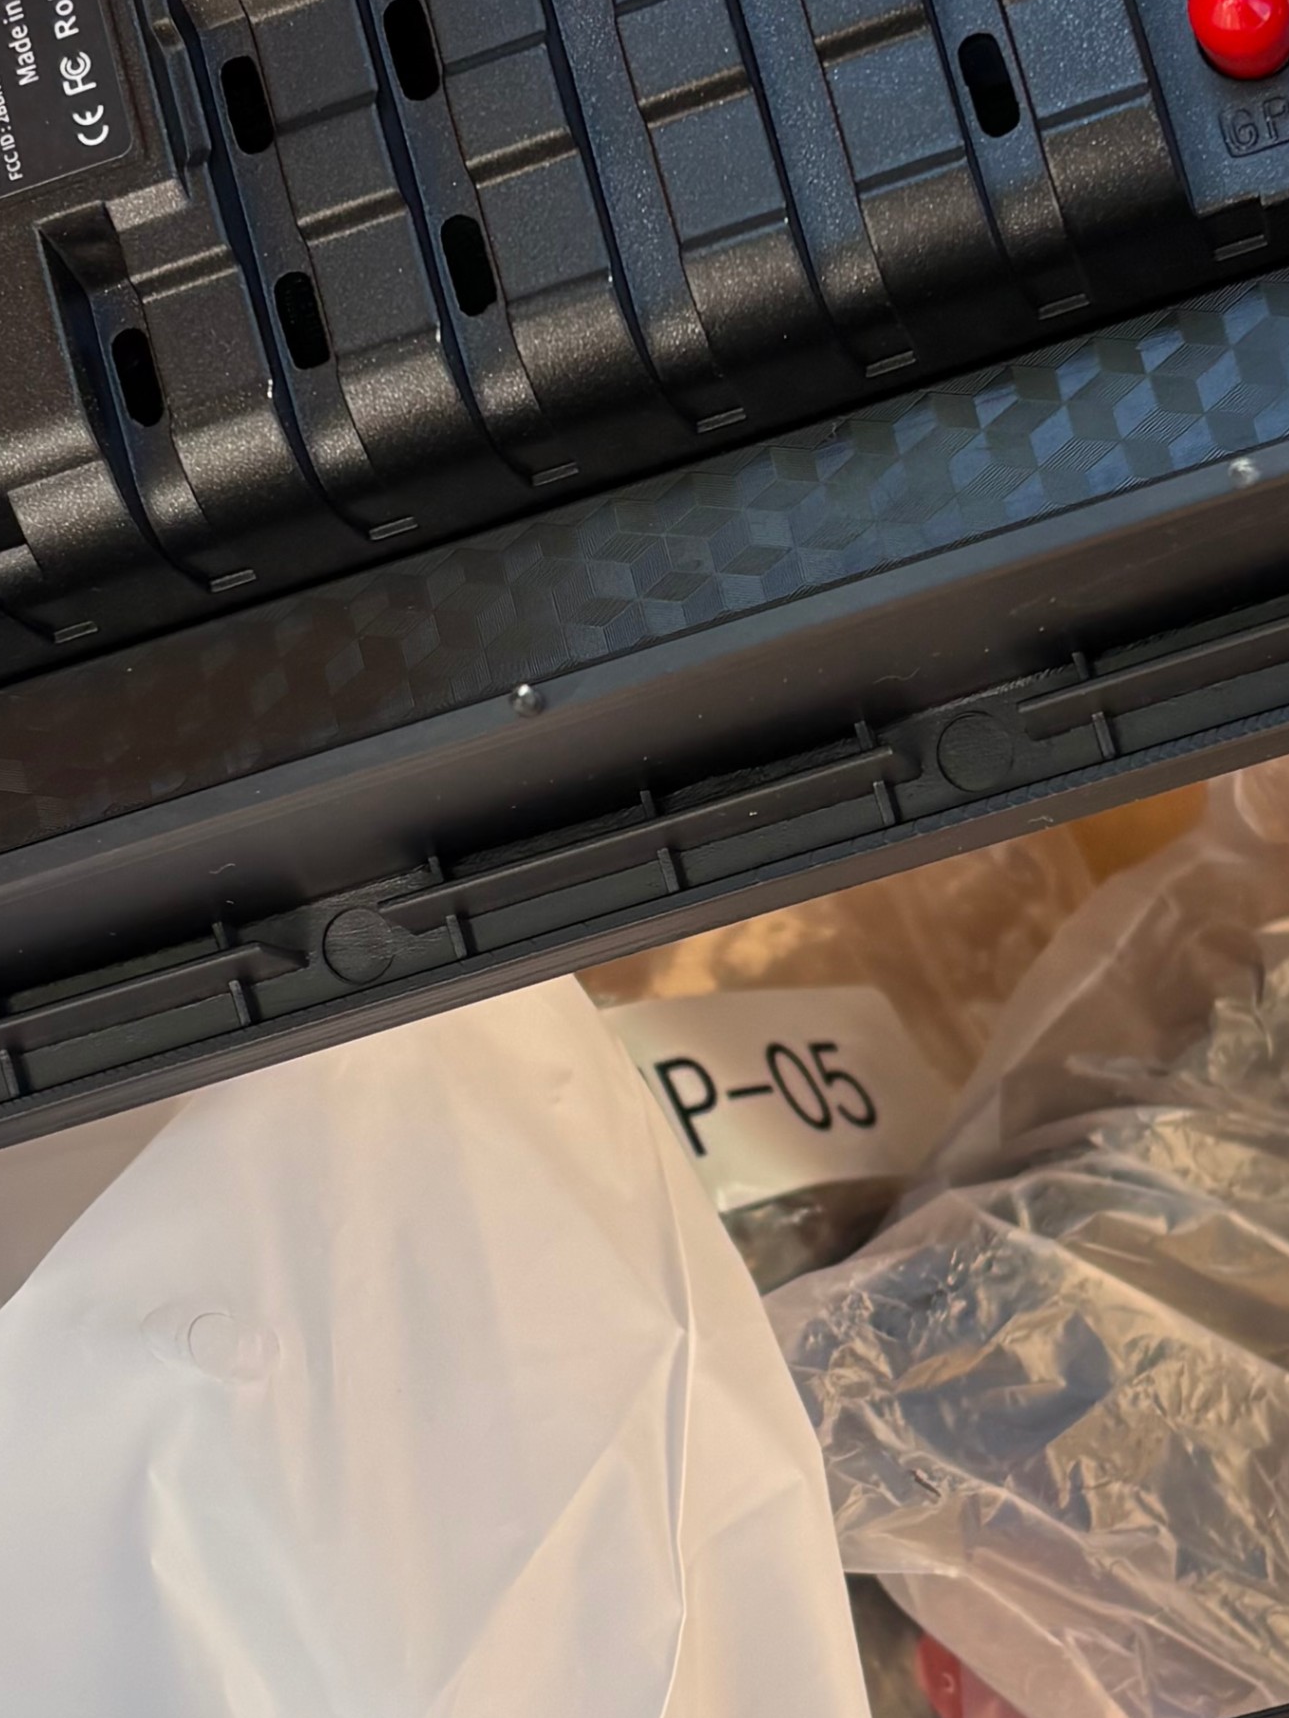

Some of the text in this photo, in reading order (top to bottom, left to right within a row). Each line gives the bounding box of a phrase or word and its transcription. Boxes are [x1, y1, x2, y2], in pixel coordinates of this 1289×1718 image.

[2, 0, 25, 25] in
[8, 24, 40, 86] Made
[3, 151, 23, 181] FCC
